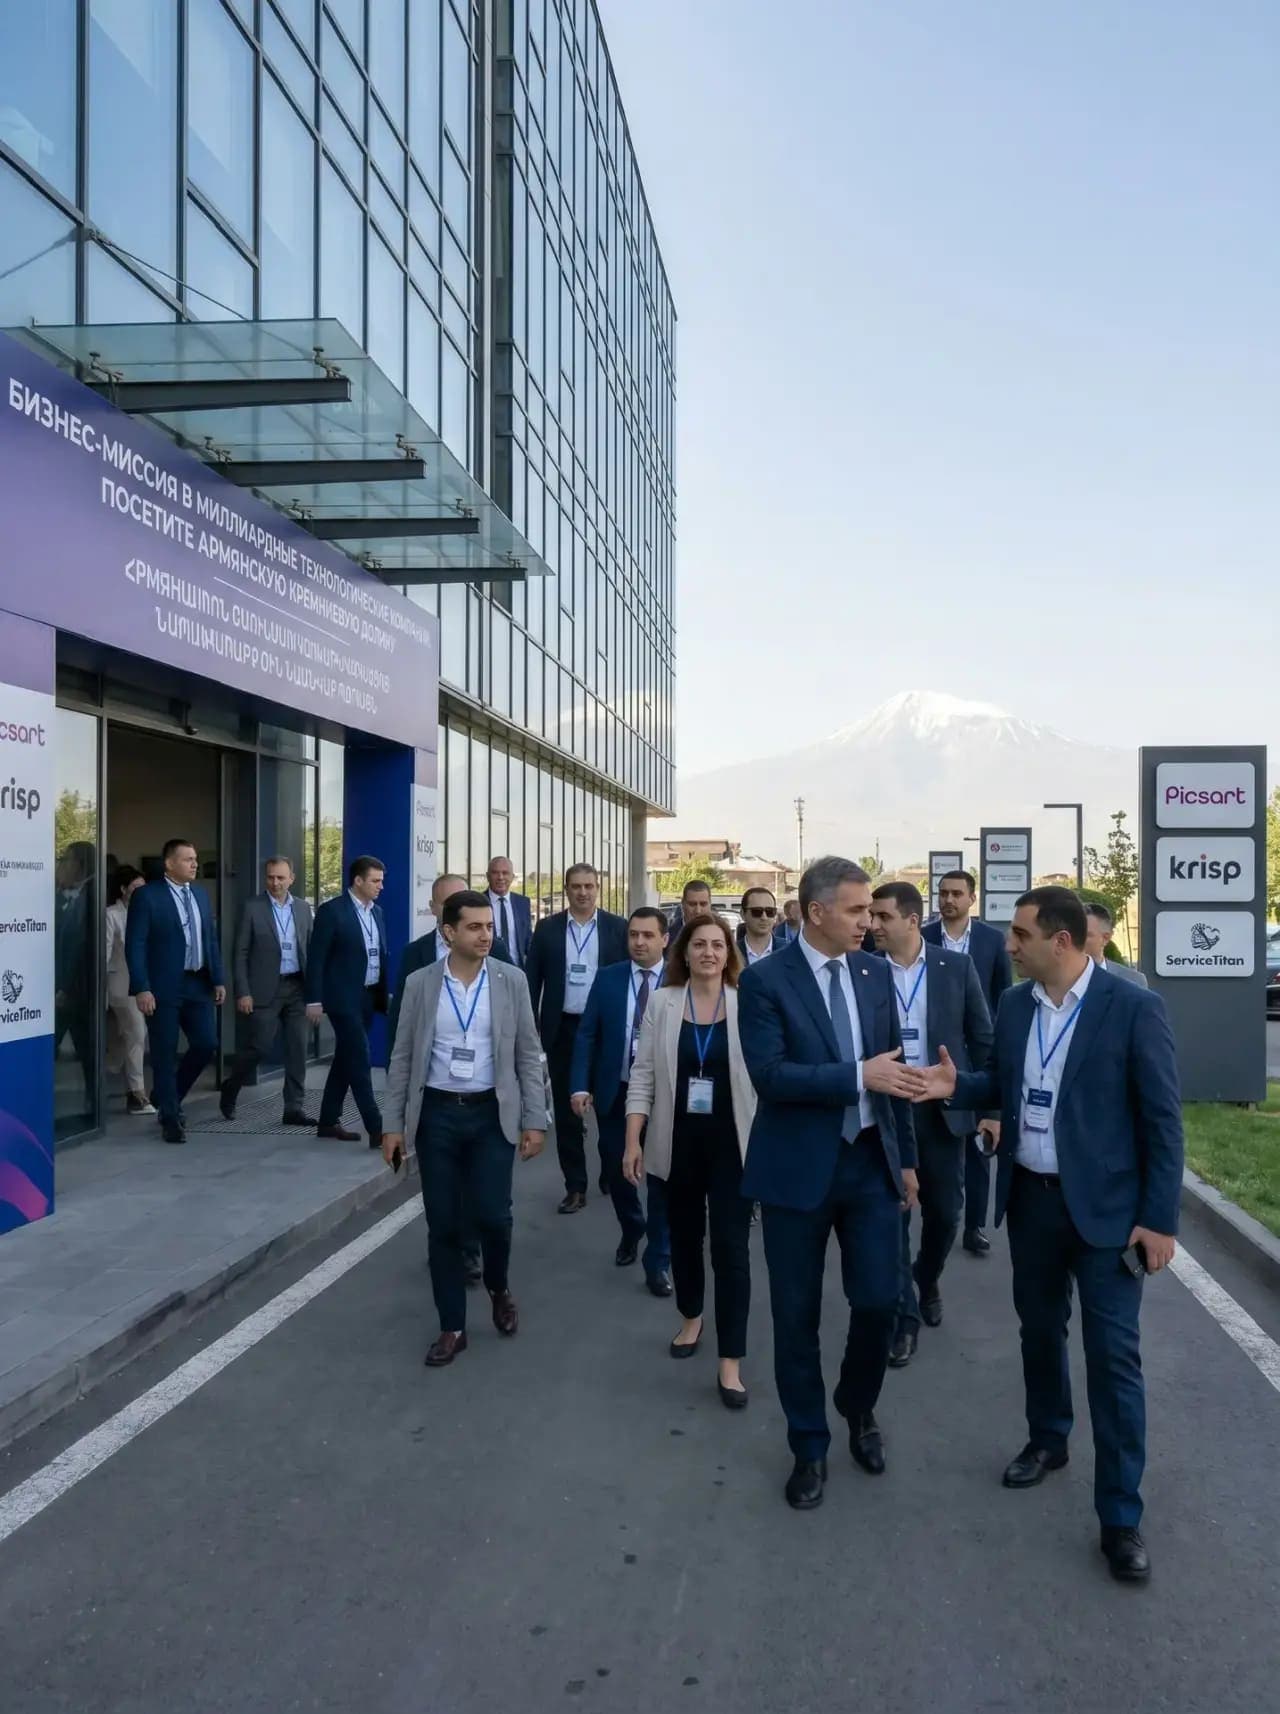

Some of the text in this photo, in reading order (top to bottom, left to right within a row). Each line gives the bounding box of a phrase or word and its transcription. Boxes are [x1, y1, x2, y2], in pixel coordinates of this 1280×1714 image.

[9, 377, 178, 502] БИЗНЕС-МИССИЯ
[182, 482, 193, 509] В
[196, 490, 298, 572] МИЛЛИАРДНЫЕ
[300, 553, 389, 624] ТЕХНОЛОГИЧЕСКИЕ
[102, 476, 194, 550] ПОСЕТИТЕ
[198, 530, 287, 597] АРМЯНСКУЮ
[288, 578, 360, 634] КРЕМНИЕВУЮ
[1165, 785, 1246, 805] Picsart
[1170, 853, 1242, 885] krisp
[1165, 954, 1245, 967] ServiceTitan
